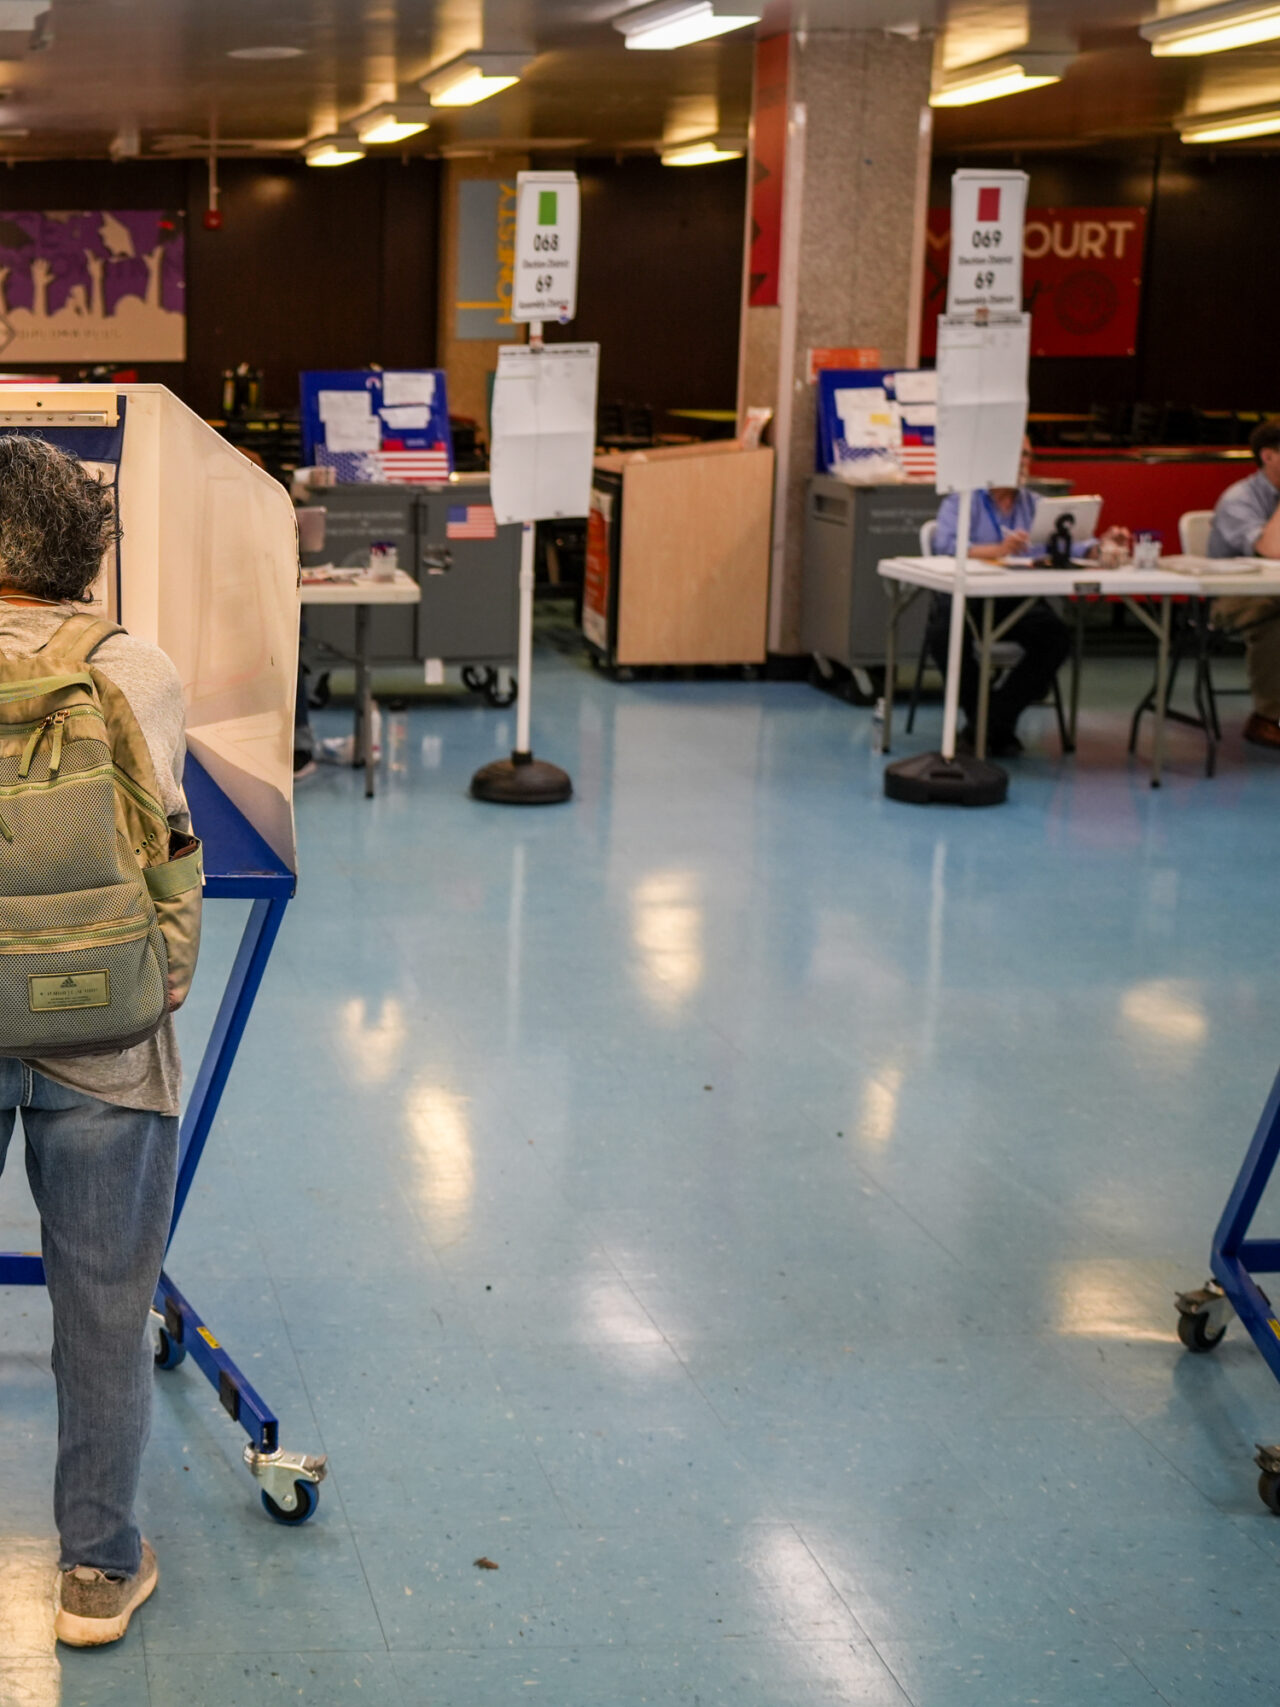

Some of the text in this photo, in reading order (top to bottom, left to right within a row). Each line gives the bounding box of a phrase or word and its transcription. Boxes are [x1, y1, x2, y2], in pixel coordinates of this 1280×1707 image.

[533, 233, 559, 252] 068
[972, 229, 1002, 249] 069
[1023, 221, 1134, 258] OURT
[535, 274, 553, 293] 69
[975, 271, 995, 290] 69
